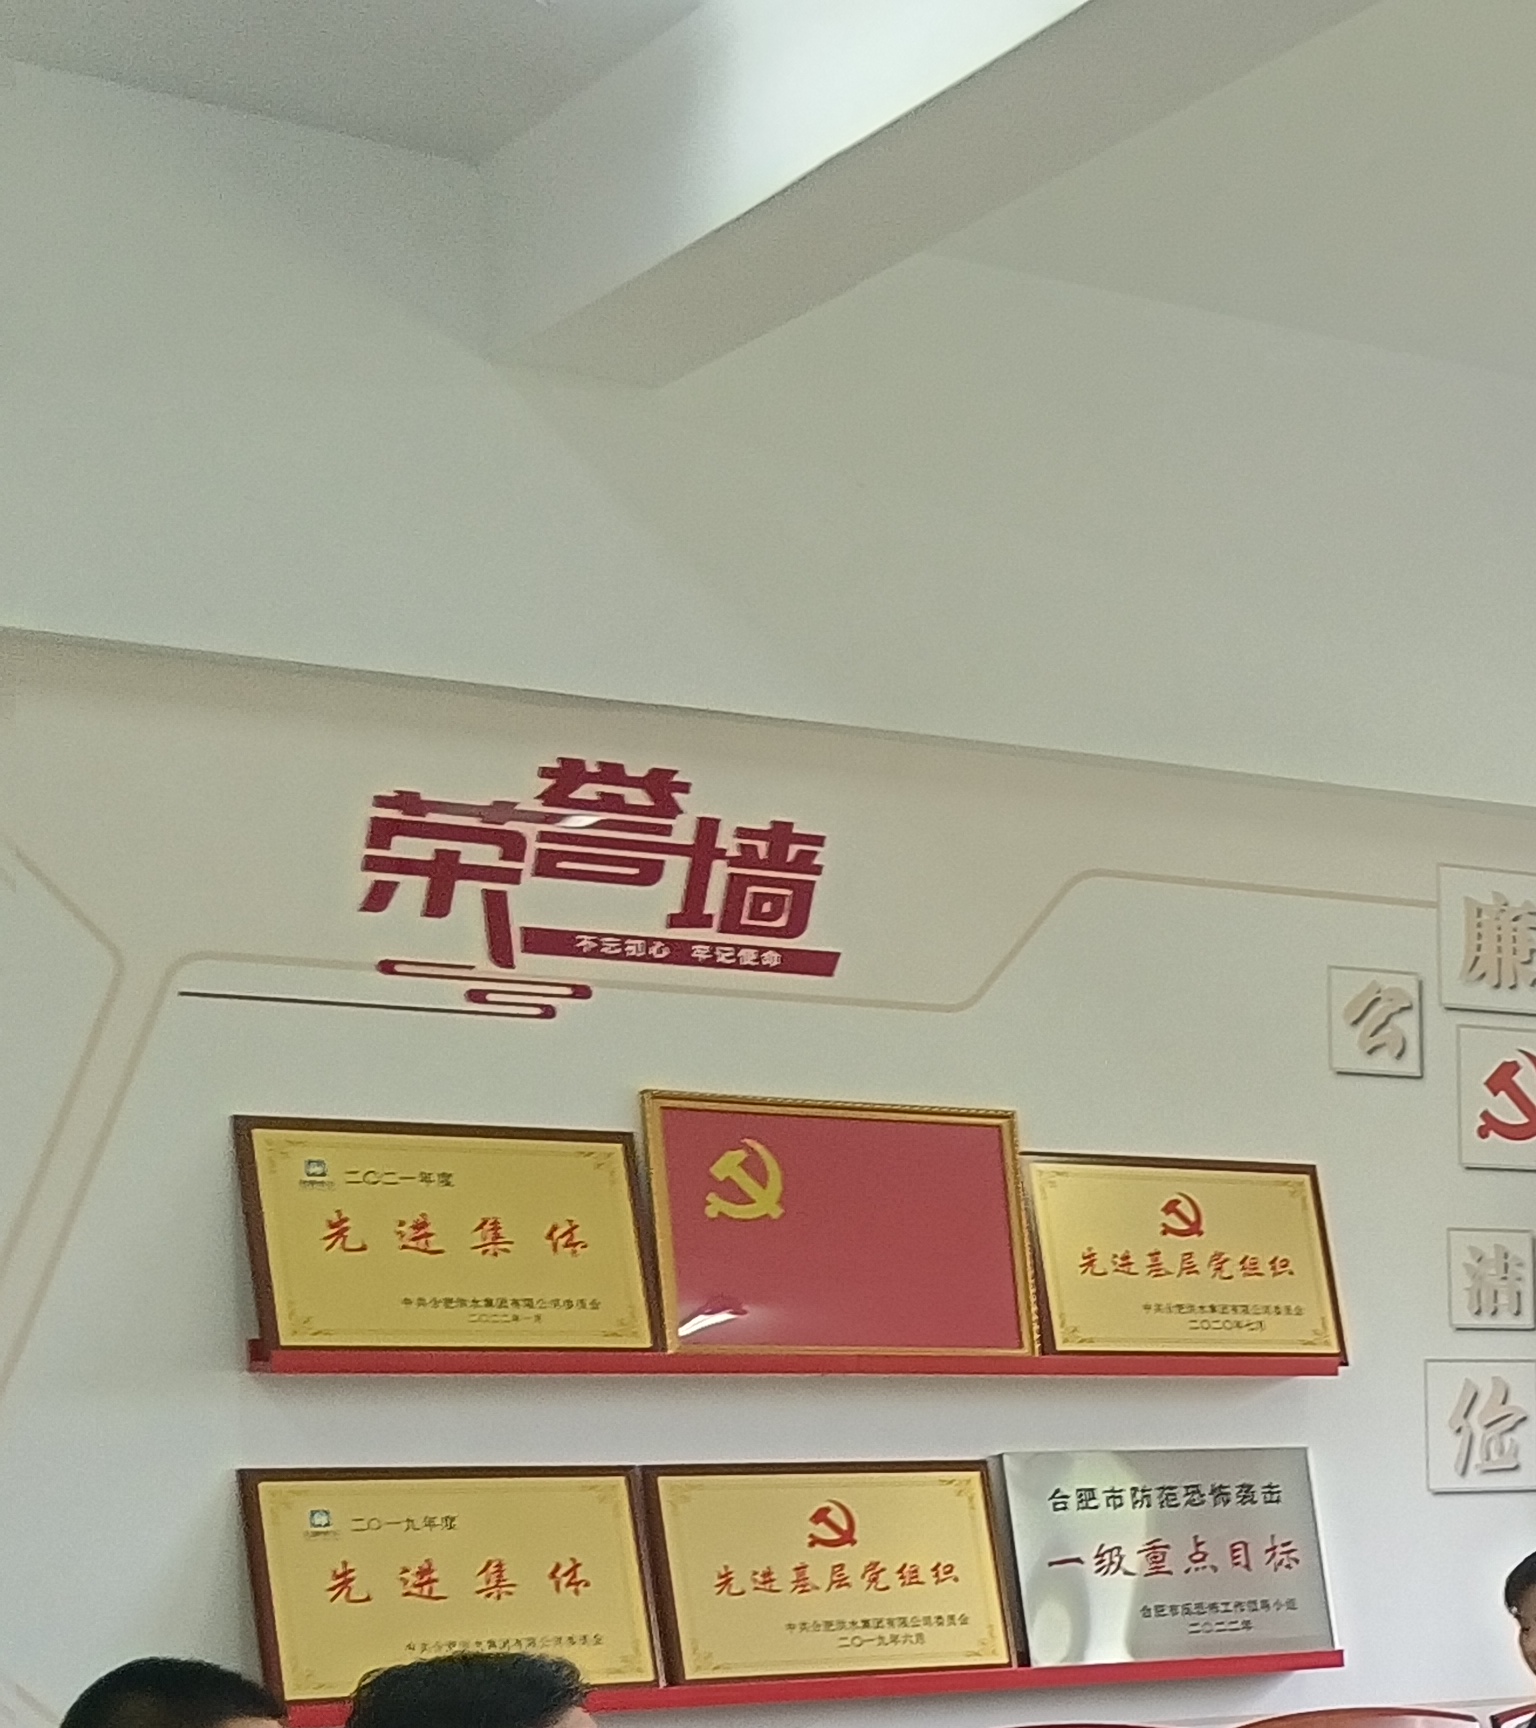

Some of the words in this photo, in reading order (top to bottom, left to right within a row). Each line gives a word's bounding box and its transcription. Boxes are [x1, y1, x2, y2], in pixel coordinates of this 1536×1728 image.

[359, 757, 827, 967] 荣誉墙
[575, 935, 671, 959] 不忘初心
[691, 945, 783, 967] 牢记使命
[321, 1210, 590, 1258] 先进集体
[1077, 1245, 1297, 1281] 先进基层党组织
[1048, 1481, 1283, 1512] 合肥市防范恐怖袭击
[1048, 1534, 1301, 1578] 一级重点目标
[325, 1556, 594, 1605] 先进集体
[713, 1560, 961, 1597] 先进基层党组织
